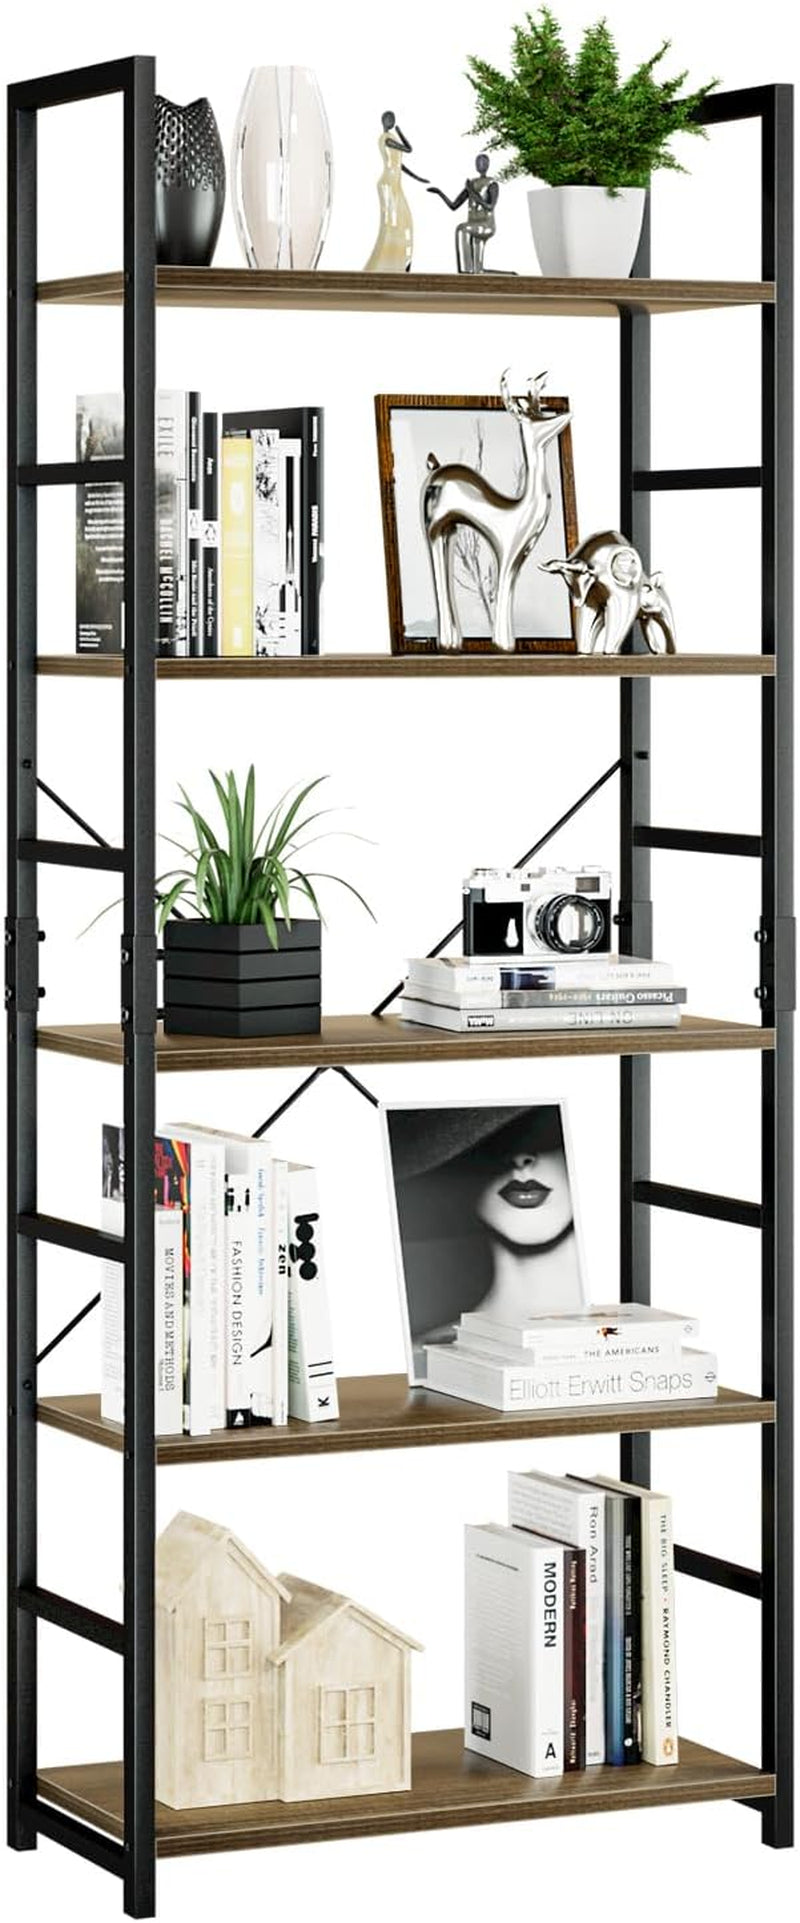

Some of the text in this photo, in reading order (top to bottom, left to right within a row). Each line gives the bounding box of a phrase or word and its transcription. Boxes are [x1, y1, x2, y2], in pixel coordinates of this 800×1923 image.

[158, 417, 174, 458] EXILE
[159, 518, 173, 561] RACHEL
[595, 991, 636, 1003] Guitars
[637, 991, 674, 1003] Picasso
[278, 1244, 287, 1274] zen
[288, 1212, 320, 1281] logo
[164, 1248, 175, 1391] MOVIES AND METHODS
[231, 1241, 243, 1366] FASHION DESIGN
[584, 1350, 601, 1358] THE
[604, 1345, 661, 1357] AMERICANS
[509, 1378, 562, 1401] Elliott
[568, 1372, 623, 1397] Erwitt
[629, 1370, 694, 1395] Snaps
[589, 1506, 599, 1584] Ron Arad
[544, 1562, 558, 1648] MODERN
[659, 1514, 672, 1728] THE BIG SLEEP RAYMOND CHANDLER
[544, 1743, 557, 1760] A
